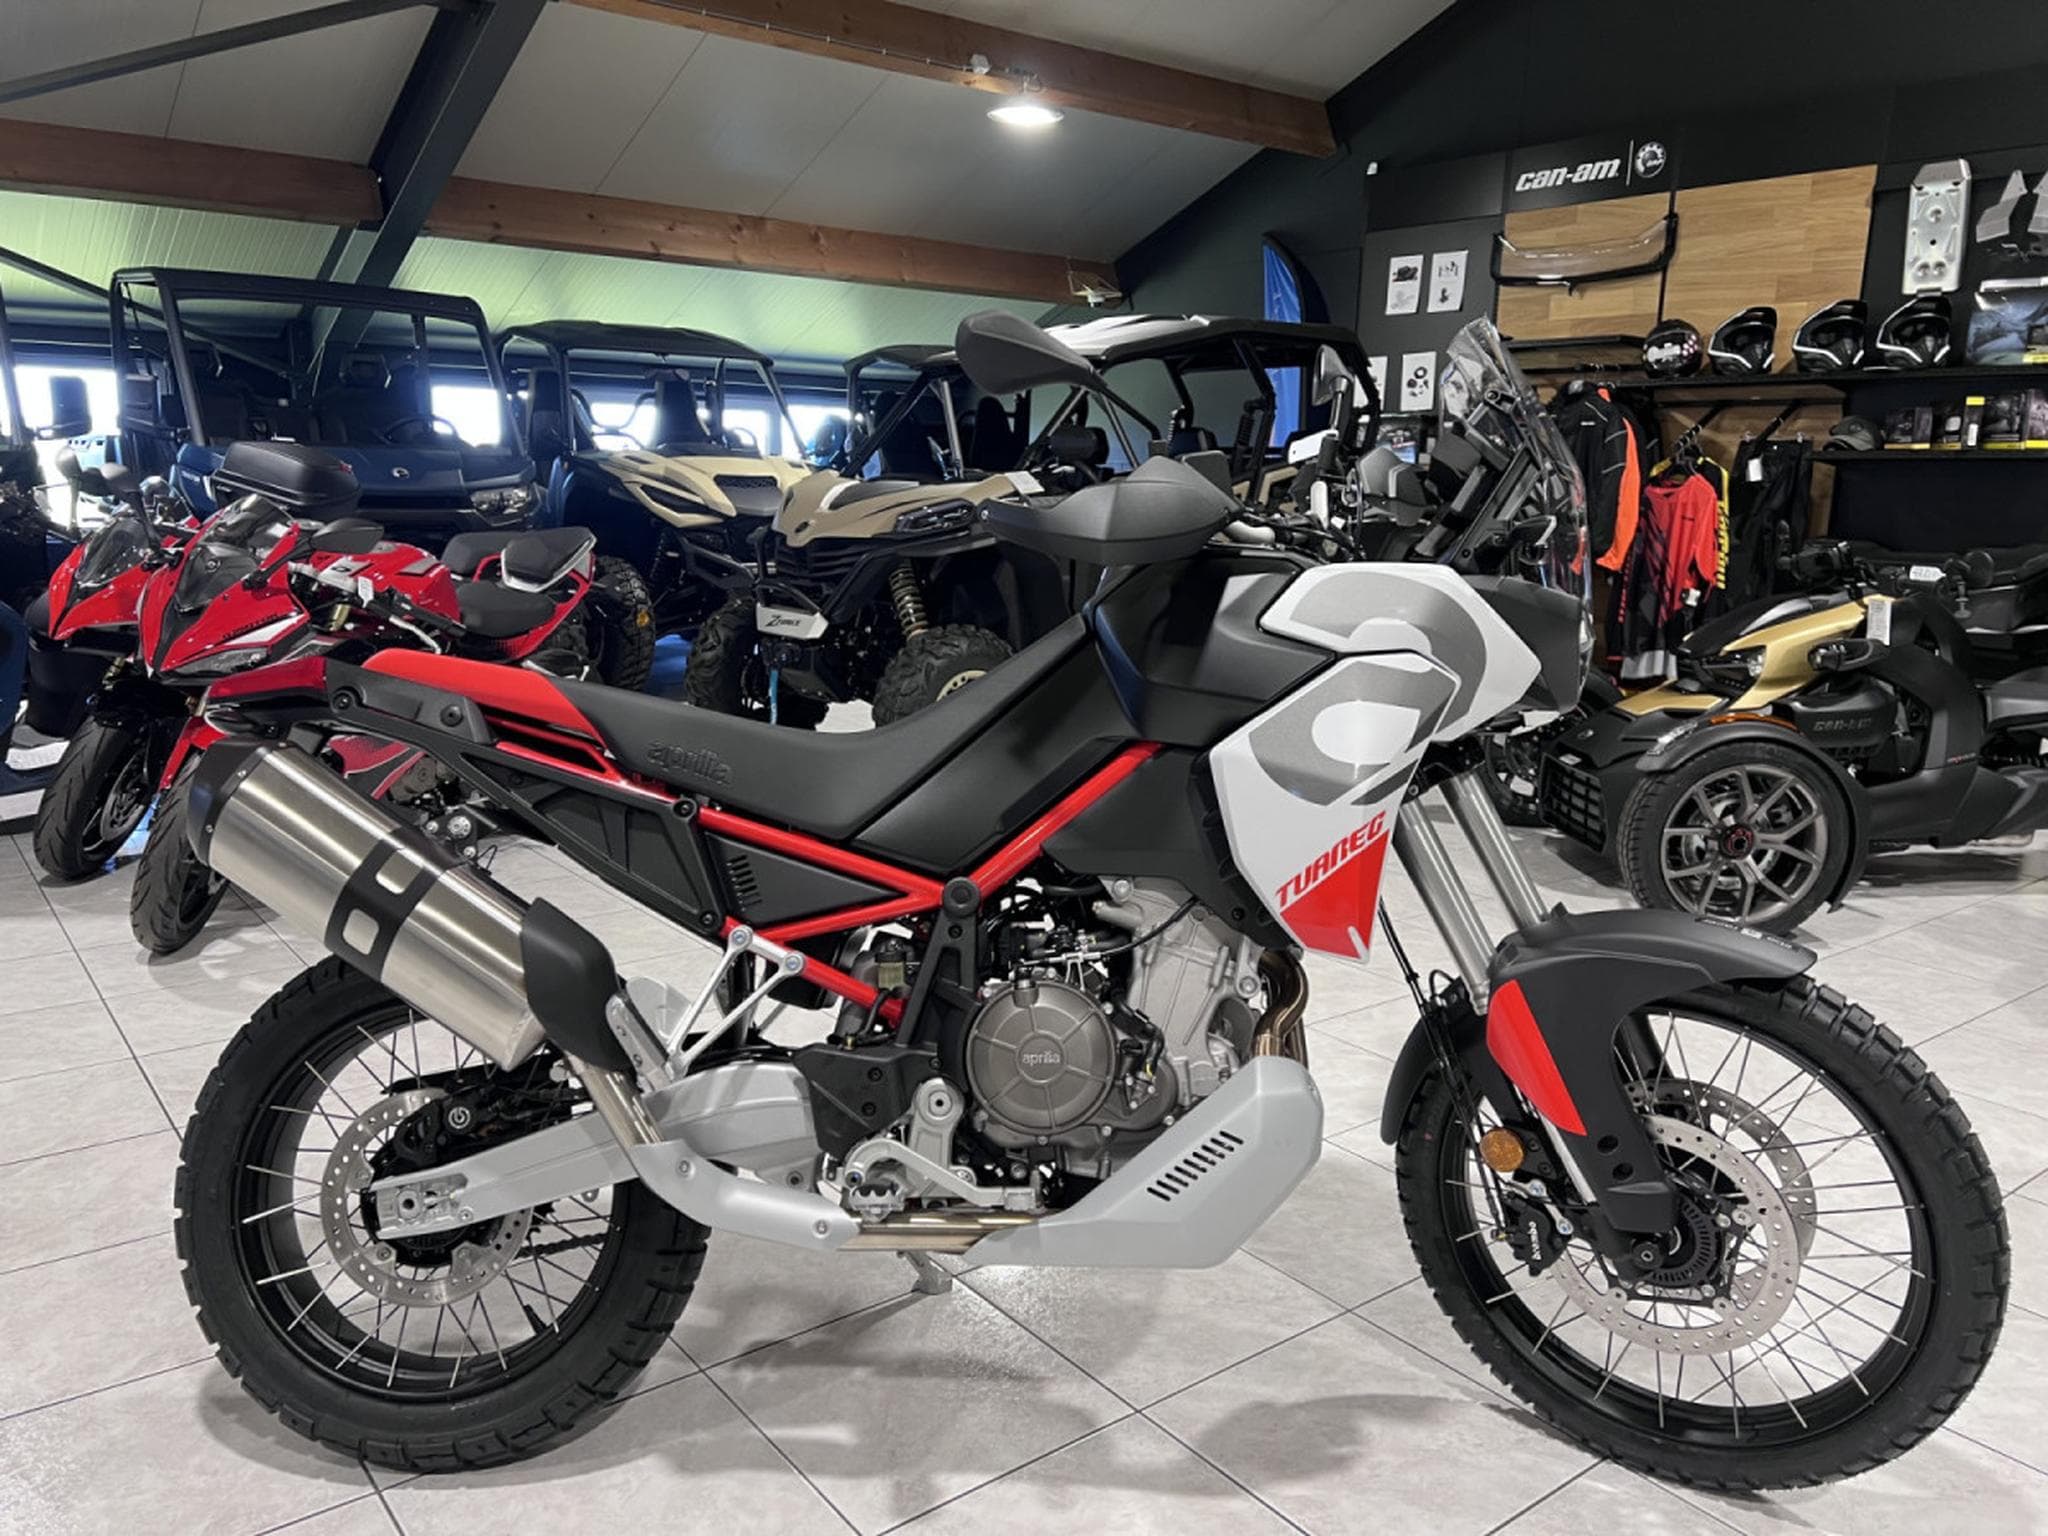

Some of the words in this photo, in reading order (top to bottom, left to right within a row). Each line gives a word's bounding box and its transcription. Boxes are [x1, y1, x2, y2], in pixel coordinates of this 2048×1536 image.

[1515, 158, 1621, 192] can-am
[1275, 810, 1387, 908] TUAREG
[1022, 1050, 1061, 1067] aprilia
[1527, 1221, 1542, 1260] brembo
